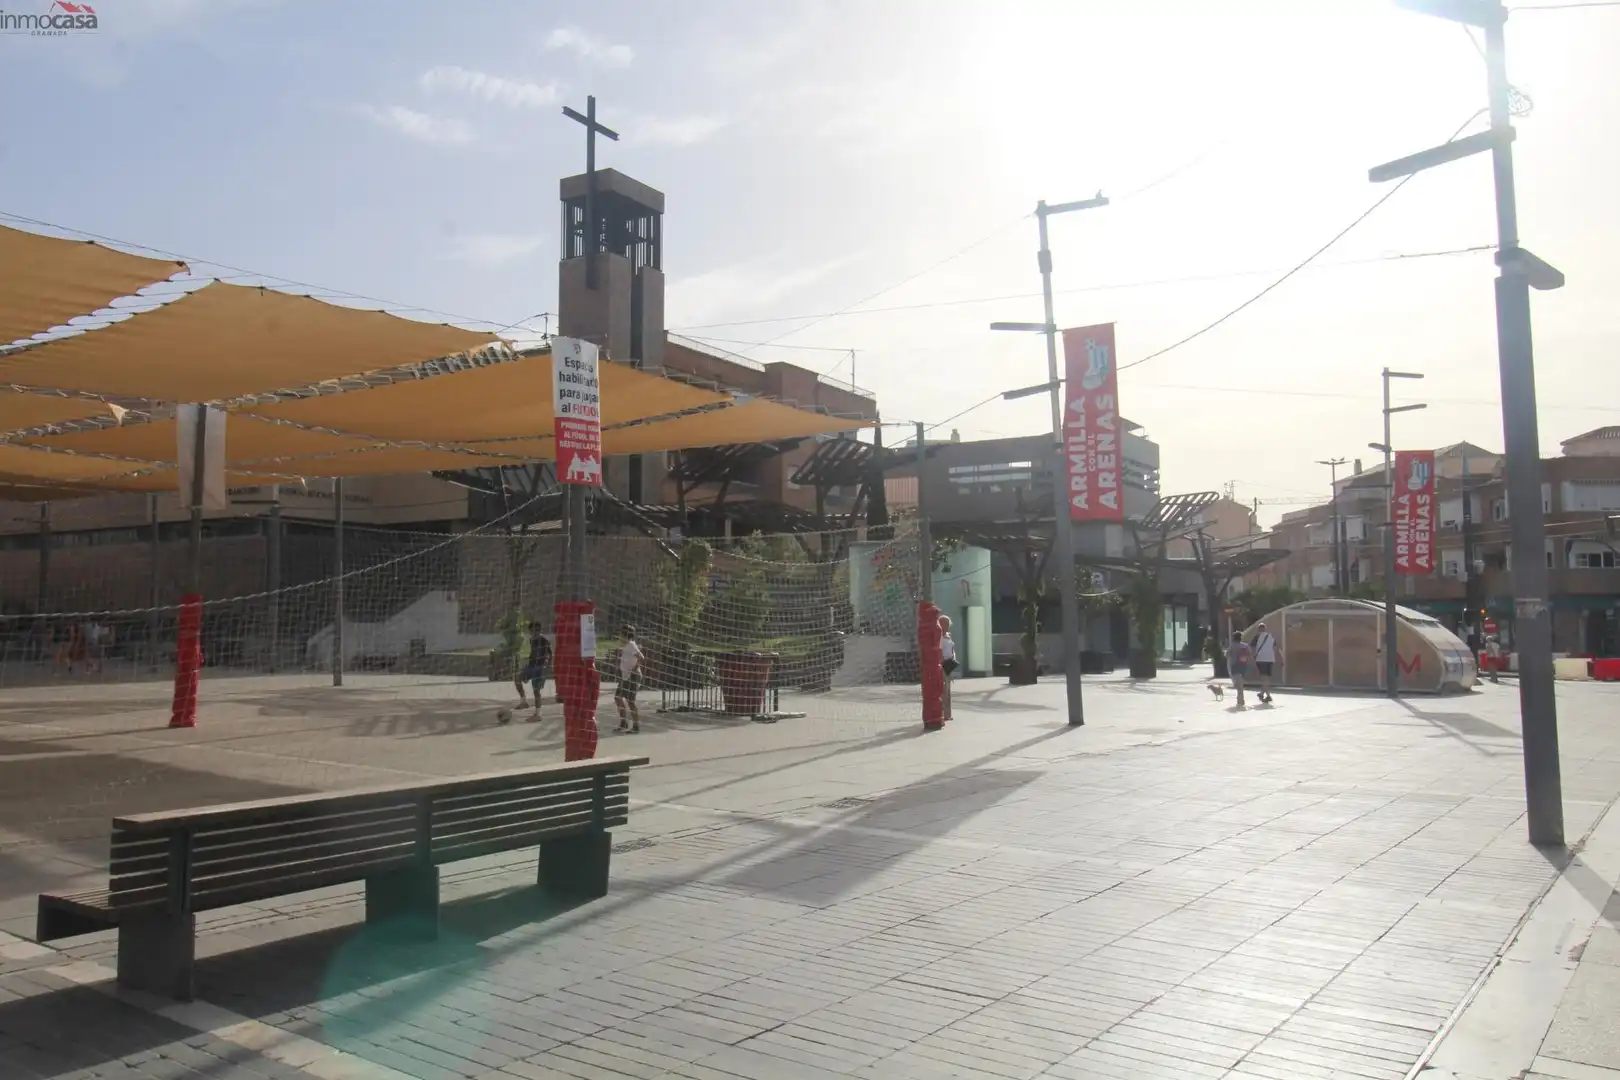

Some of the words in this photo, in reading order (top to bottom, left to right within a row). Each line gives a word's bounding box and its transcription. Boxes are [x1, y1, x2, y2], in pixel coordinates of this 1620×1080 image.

[559, 388, 581, 400] para
[561, 403, 571, 413] al
[1068, 396, 1088, 510] ARMILLA
[1087, 433, 1096, 446] EL
[1088, 450, 1096, 472] CON
[1096, 394, 1118, 510] ARENAS
[1396, 493, 1410, 568] ARMILLA
[1416, 494, 1431, 568] ARENAS
